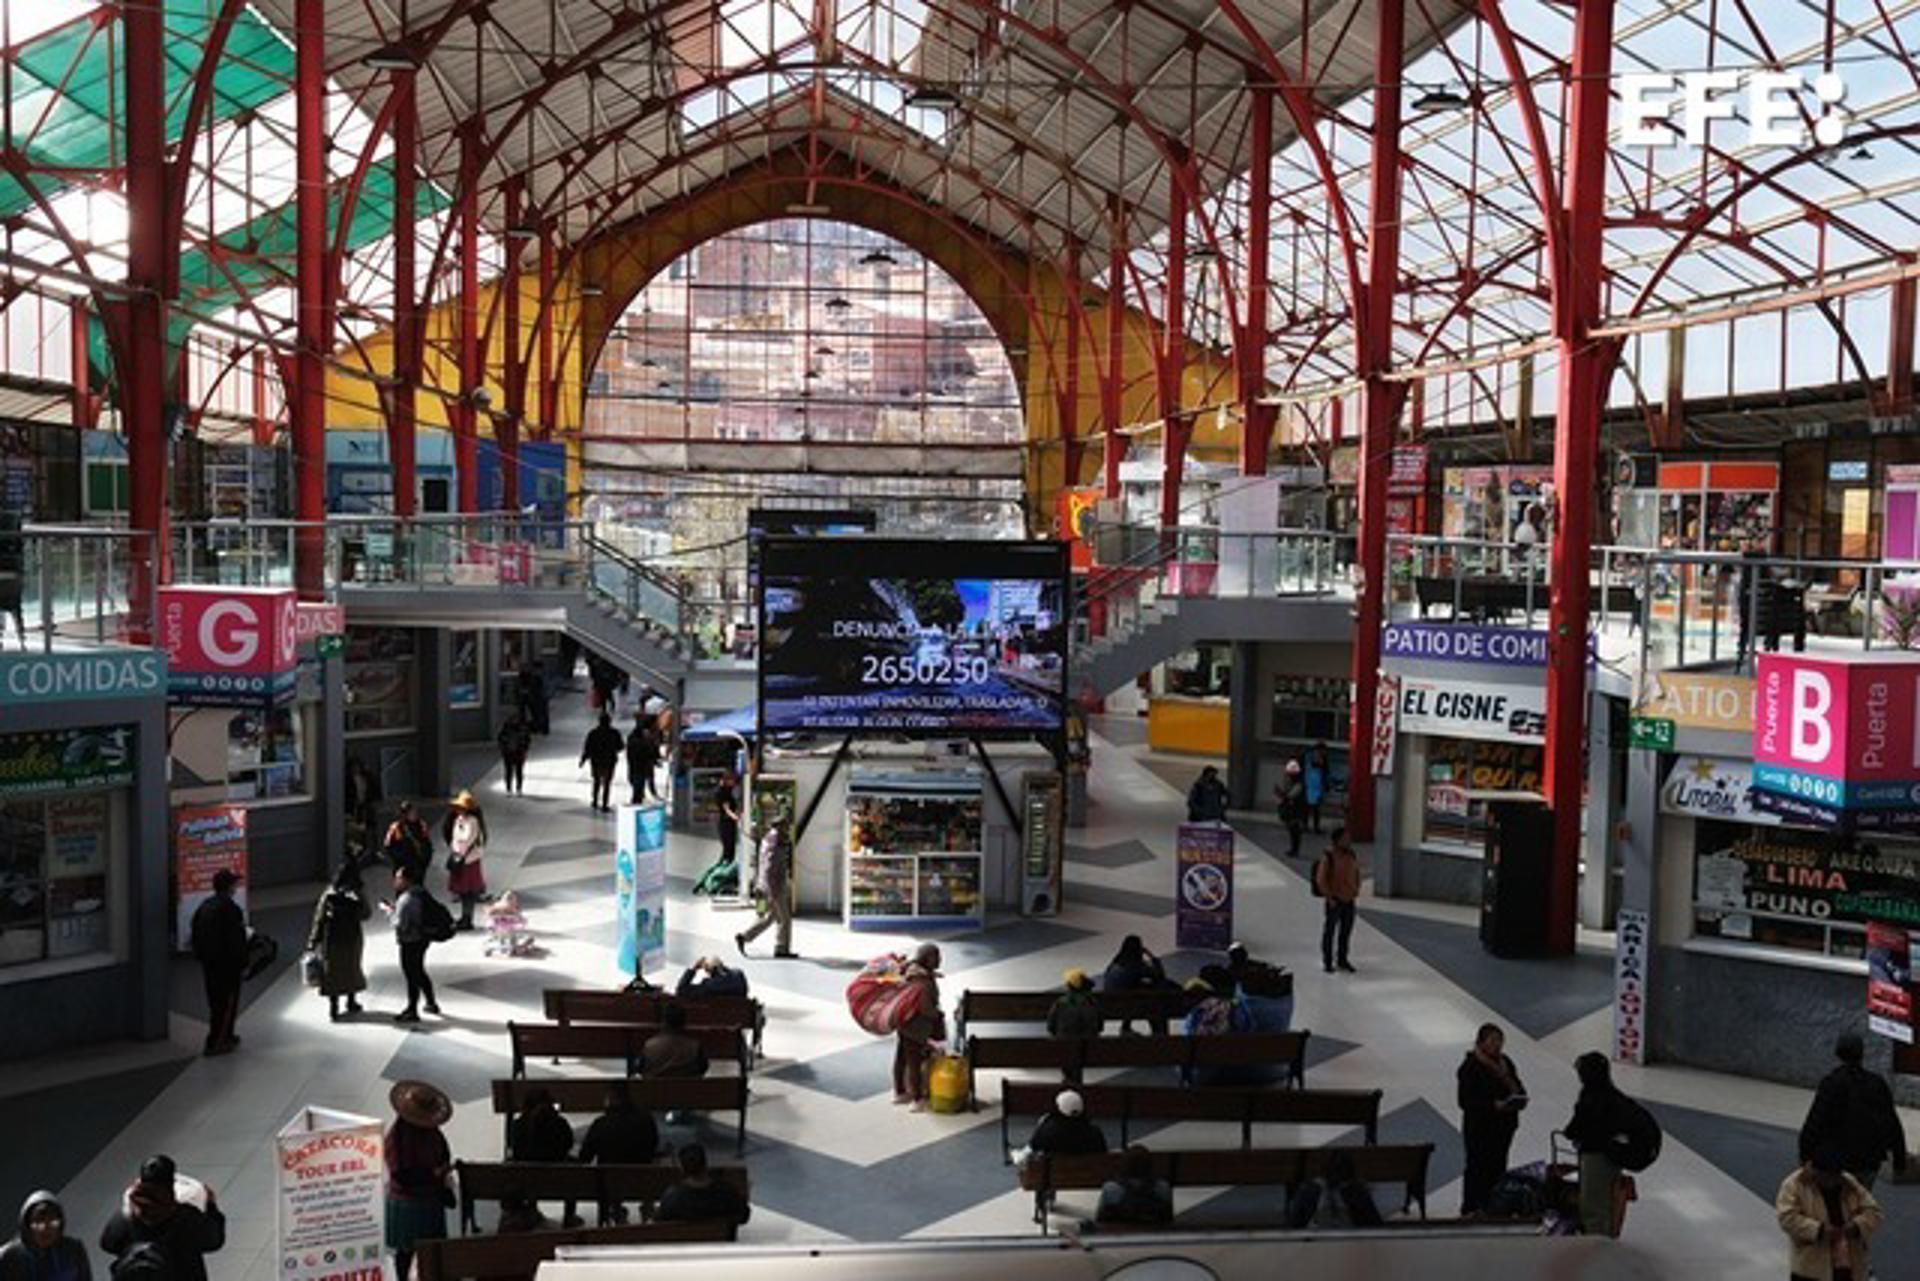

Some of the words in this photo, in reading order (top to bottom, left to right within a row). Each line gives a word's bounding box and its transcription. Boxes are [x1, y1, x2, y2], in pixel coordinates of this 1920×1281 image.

[166, 602, 184, 664] Puerta
[198, 599, 259, 667] G
[281, 599, 296, 662] G
[971, 623, 1024, 640] LIA
[1385, 629, 1450, 655] PATIO
[1455, 632, 1484, 656] DE
[8, 657, 159, 695] COMIDAS
[861, 655, 989, 684] 2650250
[1403, 689, 1428, 715] EL
[1435, 692, 1507, 722] CISNE
[1762, 671, 1781, 754] Puerta
[1790, 668, 1832, 763] B
[1862, 682, 1889, 770] Puerta
[1766, 863, 1848, 891] LIMA
[1752, 892, 1832, 918] PUNO
